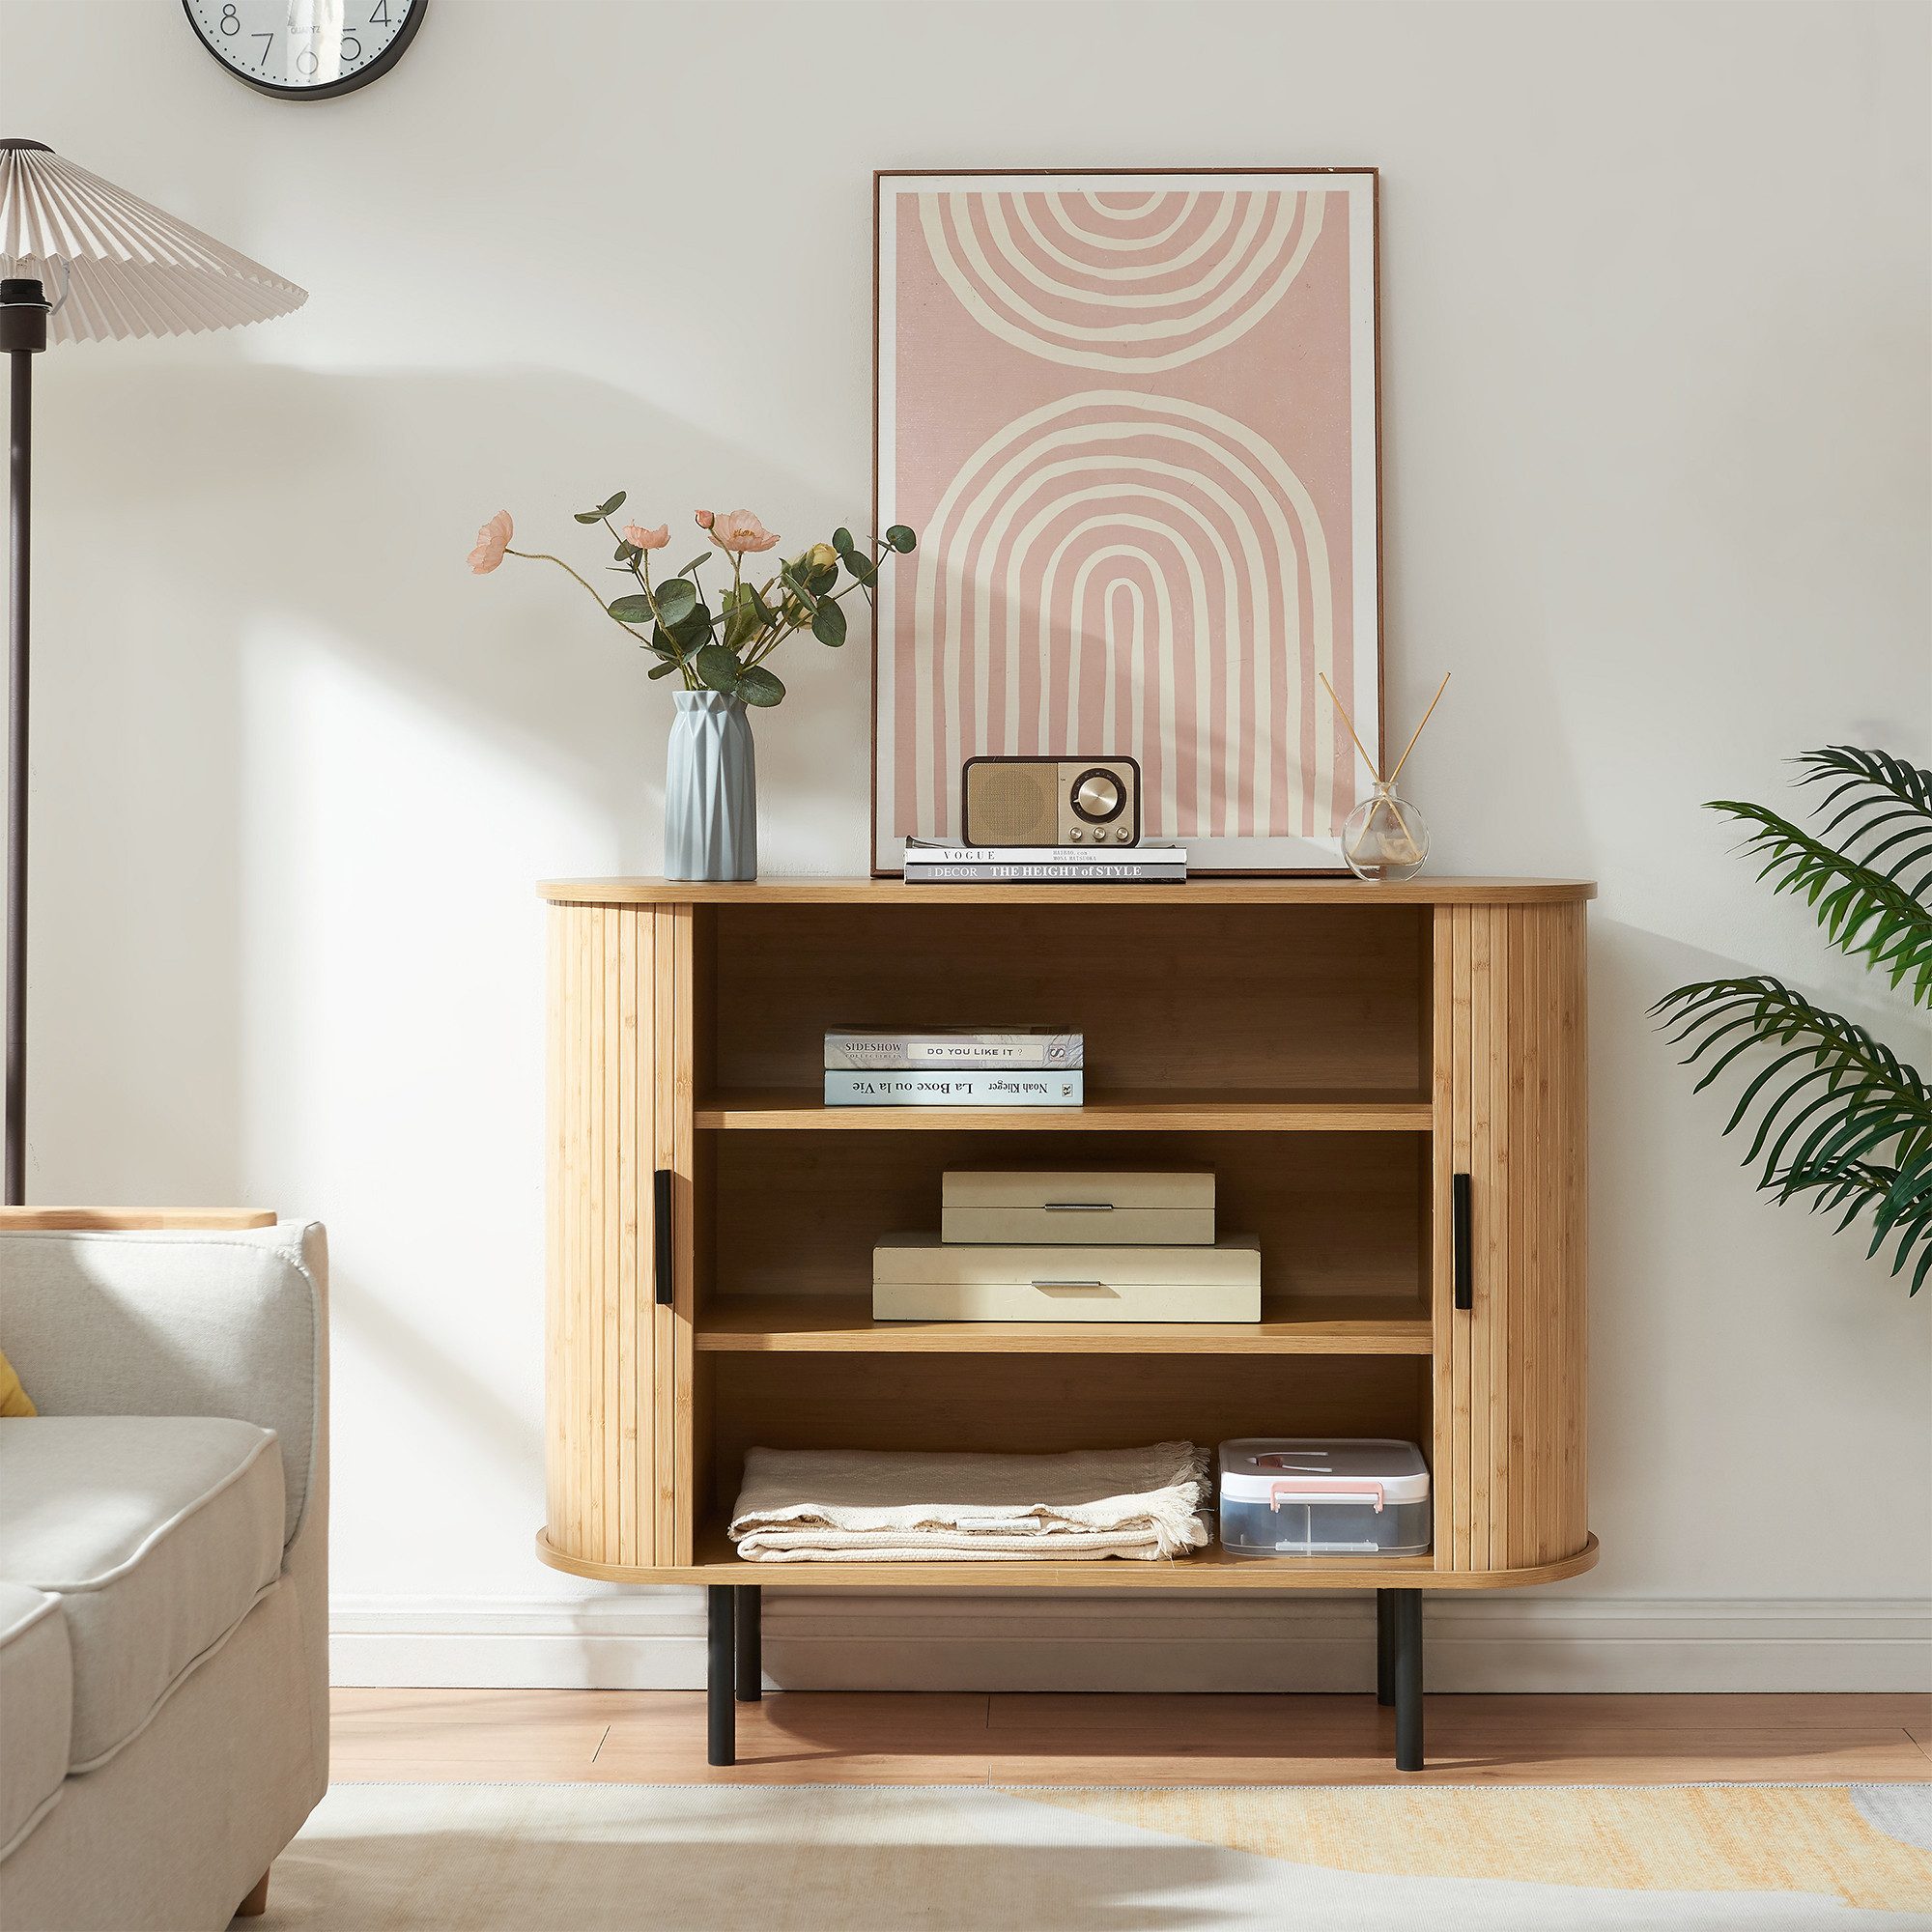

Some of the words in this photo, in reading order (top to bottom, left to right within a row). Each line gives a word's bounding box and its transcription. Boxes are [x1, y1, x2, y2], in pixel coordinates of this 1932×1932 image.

[369, 0, 392, 27] 4
[220, 4, 241, 36] 8
[251, 33, 274, 66] 7
[296, 44, 319, 75] 6
[944, 851, 995, 860] VOGUE
[934, 867, 979, 877] DECOR
[989, 866, 1020, 877] THE
[1022, 866, 1079, 877] HEIGHT
[1081, 866, 1094, 877] of
[1095, 866, 1142, 876] STYLE
[845, 1042, 902, 1051] SIDESHOW
[852, 1082, 875, 1094] Vie
[879, 1082, 892, 1094] la
[895, 1082, 913, 1091] ou
[917, 1082, 951, 1094] Boxe
[954, 1082, 974, 1094] La
[988, 1079, 1020, 1094] Klieger
[1022, 1083, 1048, 1094] Noah
